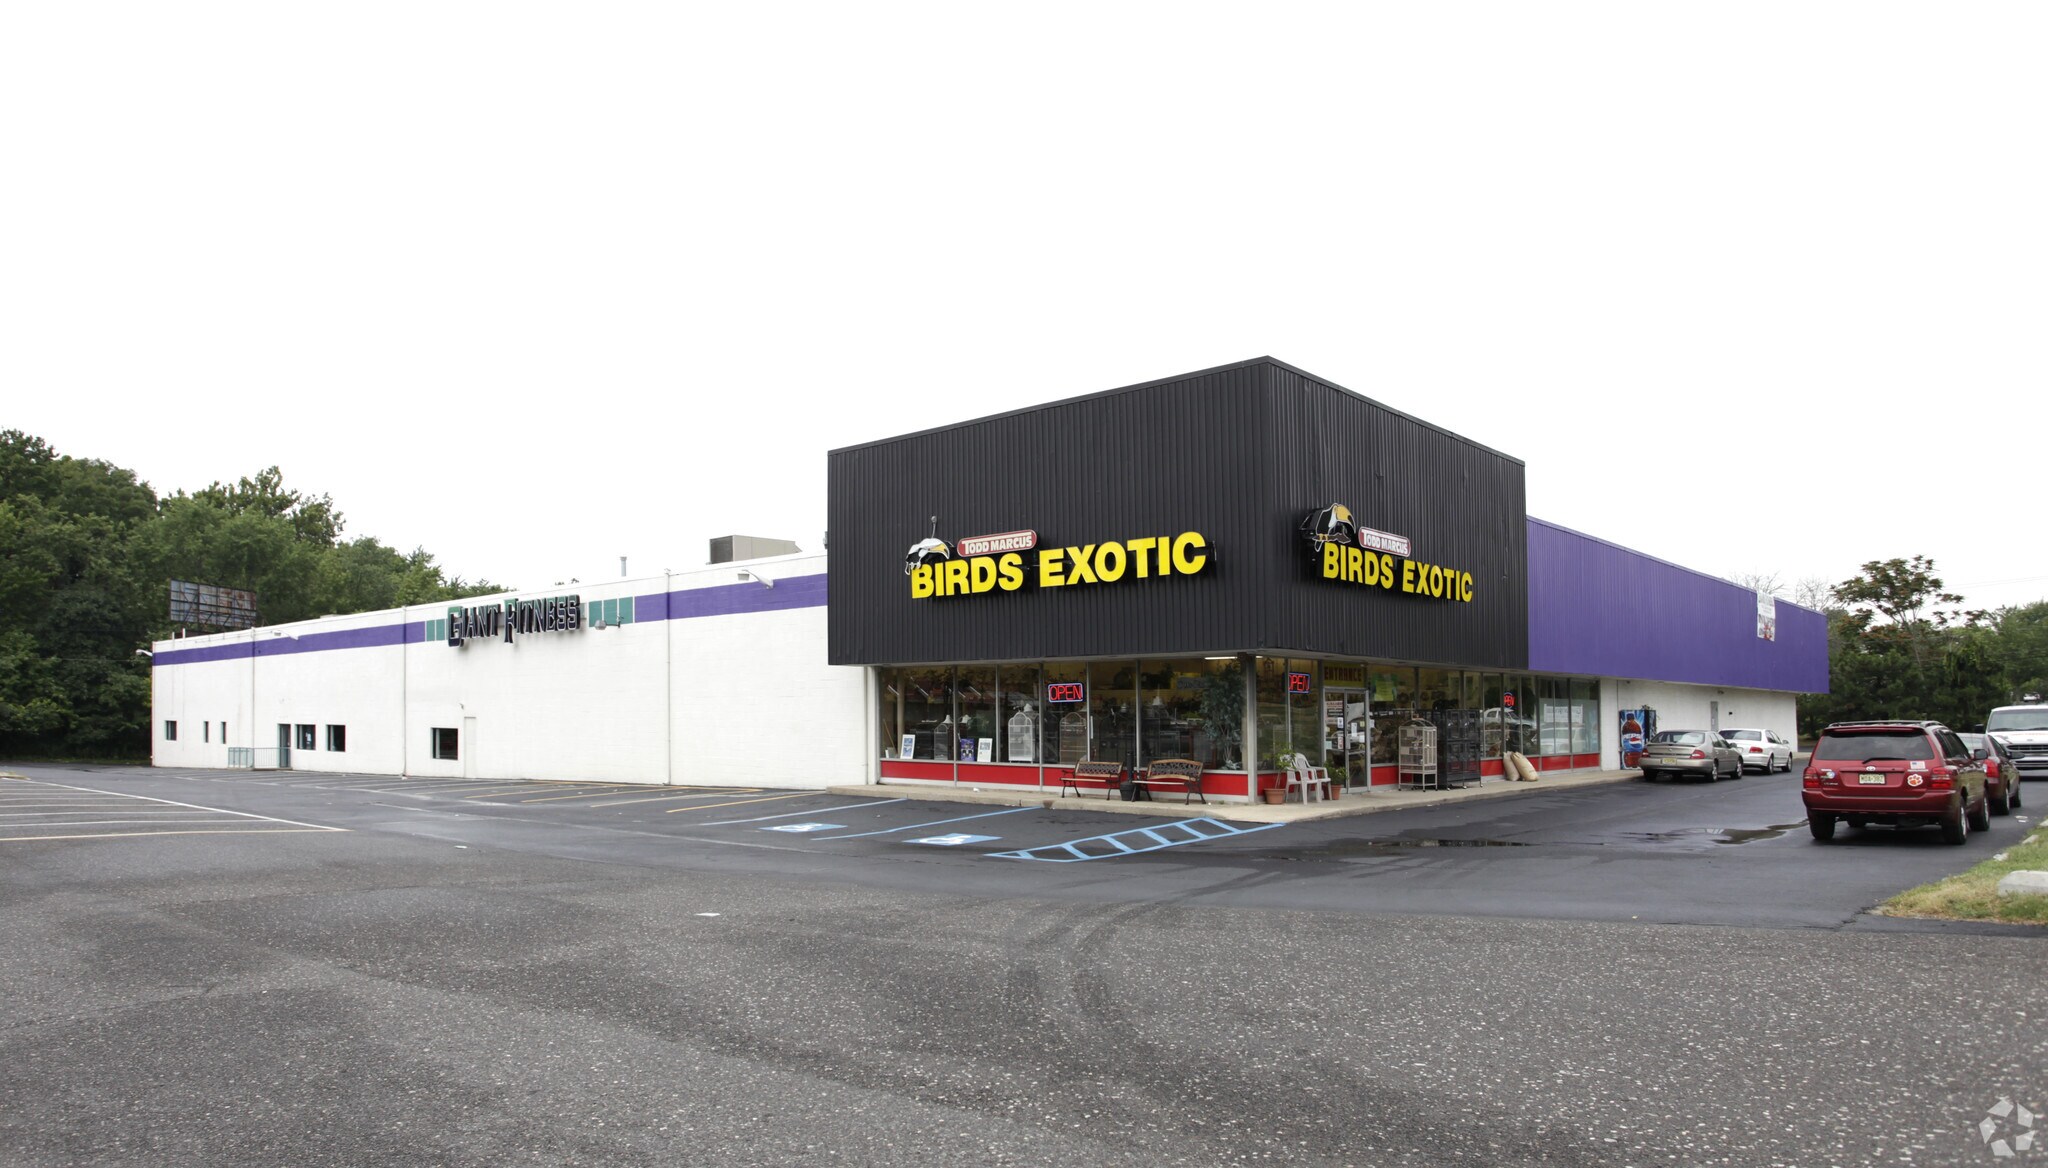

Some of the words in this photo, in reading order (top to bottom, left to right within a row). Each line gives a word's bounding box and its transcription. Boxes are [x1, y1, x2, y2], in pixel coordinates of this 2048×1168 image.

[961, 538, 989, 554] TODD
[989, 533, 1033, 552] MARCUS
[1361, 529, 1381, 548] TODD
[1381, 535, 1408, 555] MARCUS
[911, 552, 1024, 599] BIRDS
[1039, 531, 1207, 588] EXOTIC
[1323, 542, 1394, 590] BIRDS
[1402, 559, 1473, 603] EXOTIC
[447, 603, 502, 648] GIANT
[504, 594, 581, 644] FITNESS
[1324, 666, 1362, 682] ENTRANCE
[1050, 685, 1082, 701] OPEN
